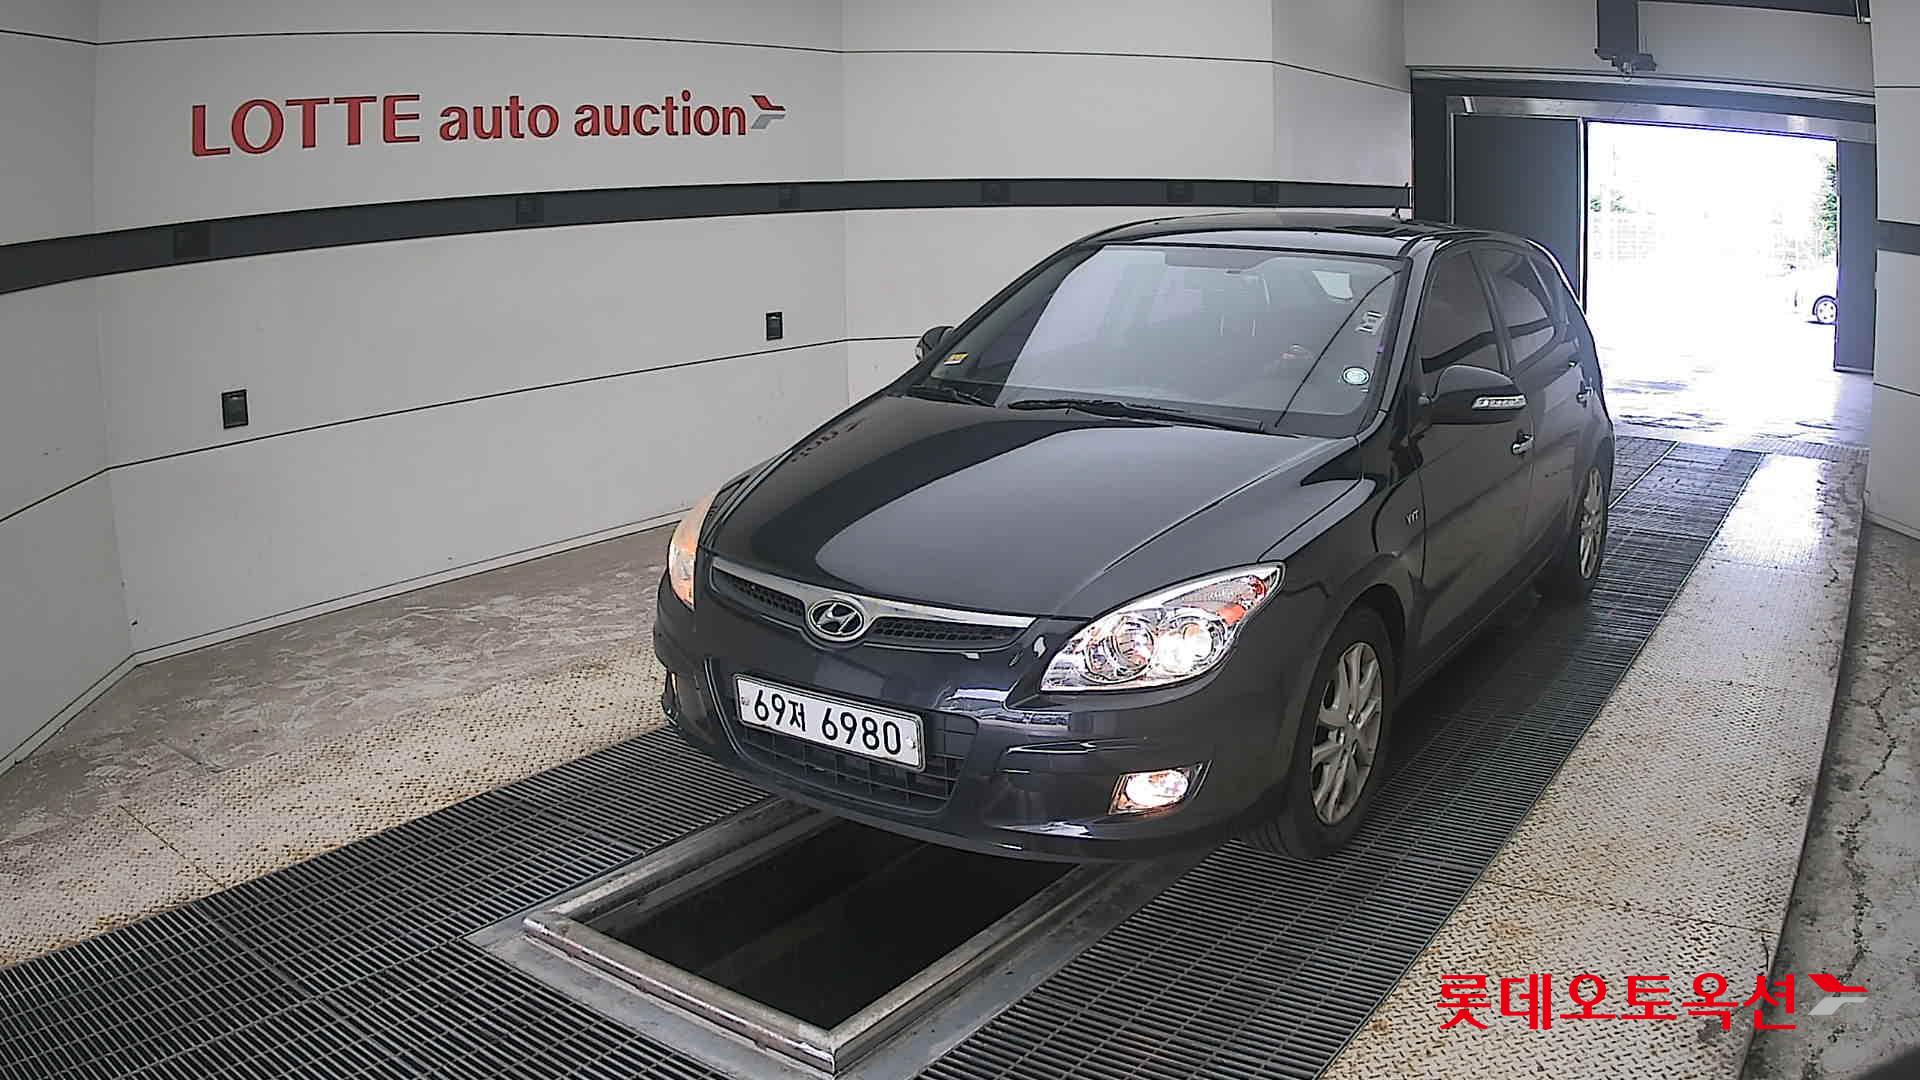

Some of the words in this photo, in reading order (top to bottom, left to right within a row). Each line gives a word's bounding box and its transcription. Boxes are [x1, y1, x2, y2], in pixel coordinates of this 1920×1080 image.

[191, 94, 420, 157] LOTTE
[438, 95, 561, 141] auto
[573, 89, 747, 137] auction
[753, 689, 807, 732] 69저
[821, 707, 901, 756] 6980
